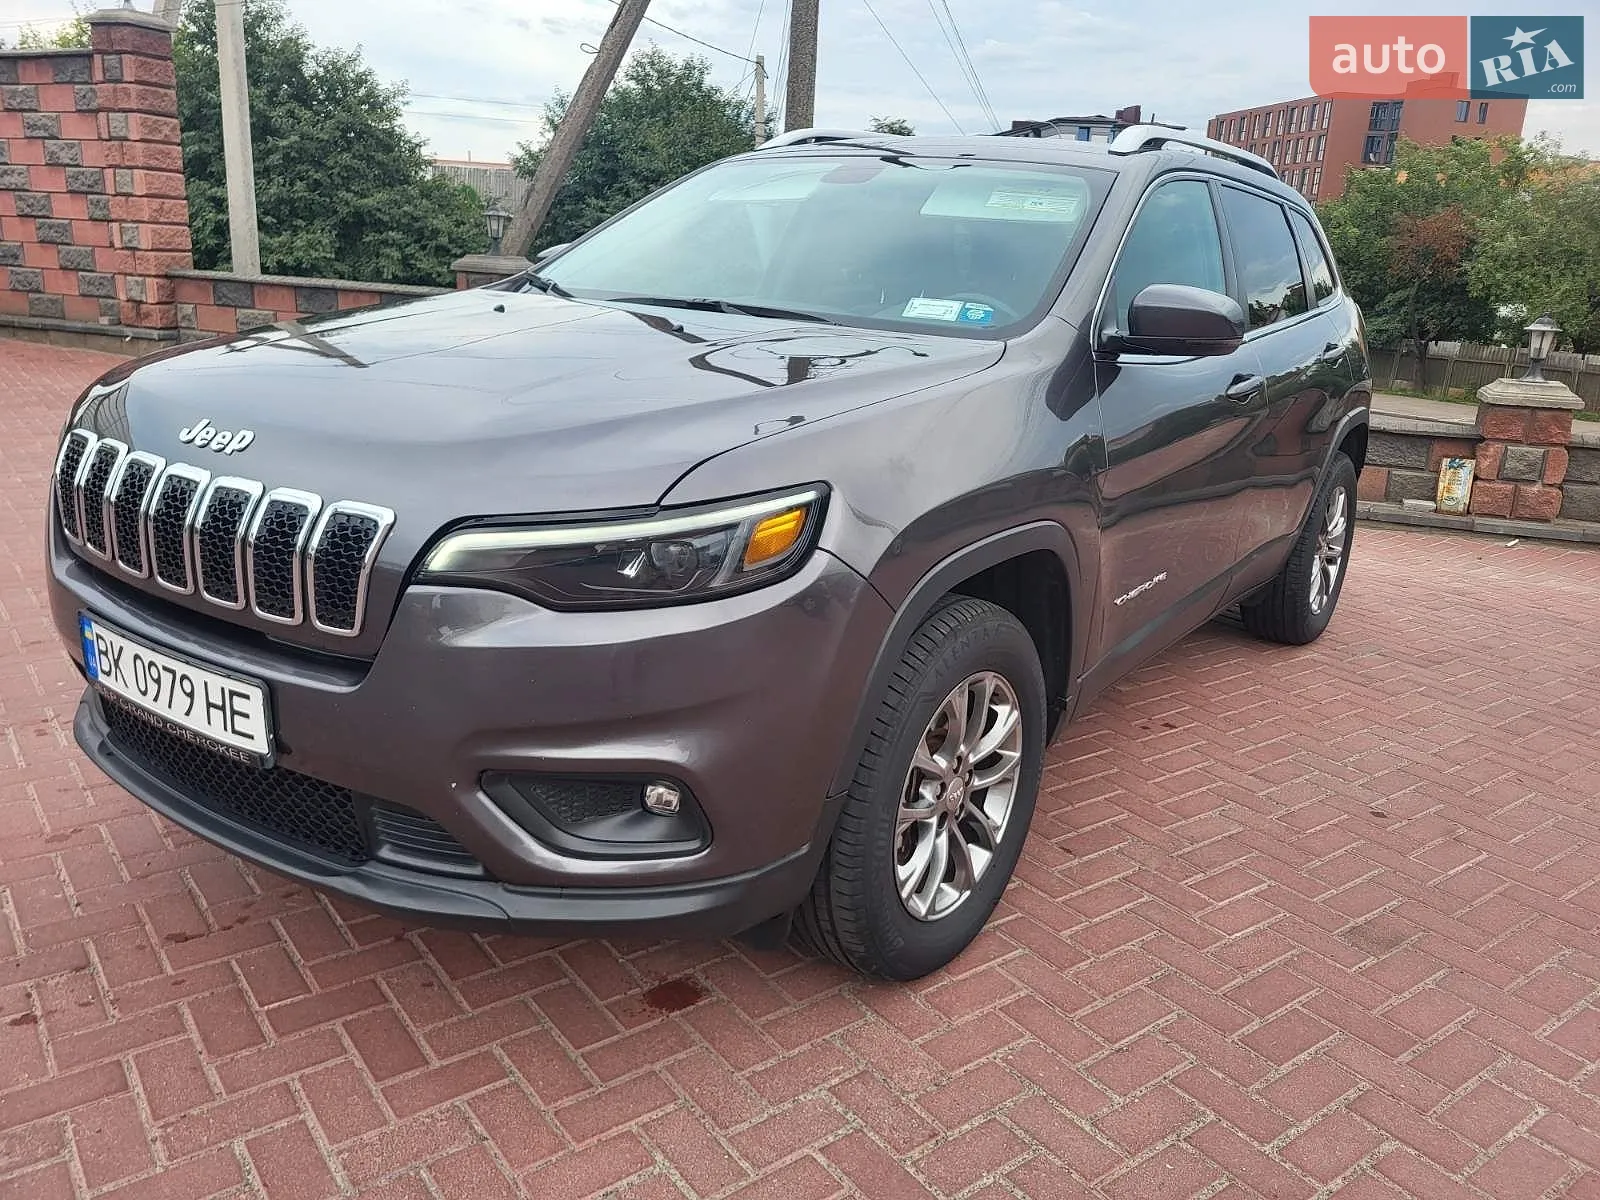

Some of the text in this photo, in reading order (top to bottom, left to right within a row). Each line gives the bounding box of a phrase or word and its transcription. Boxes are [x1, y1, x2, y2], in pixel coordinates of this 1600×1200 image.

[179, 418, 255, 456] Jeep
[96, 632, 255, 740] BK 0979 HE
